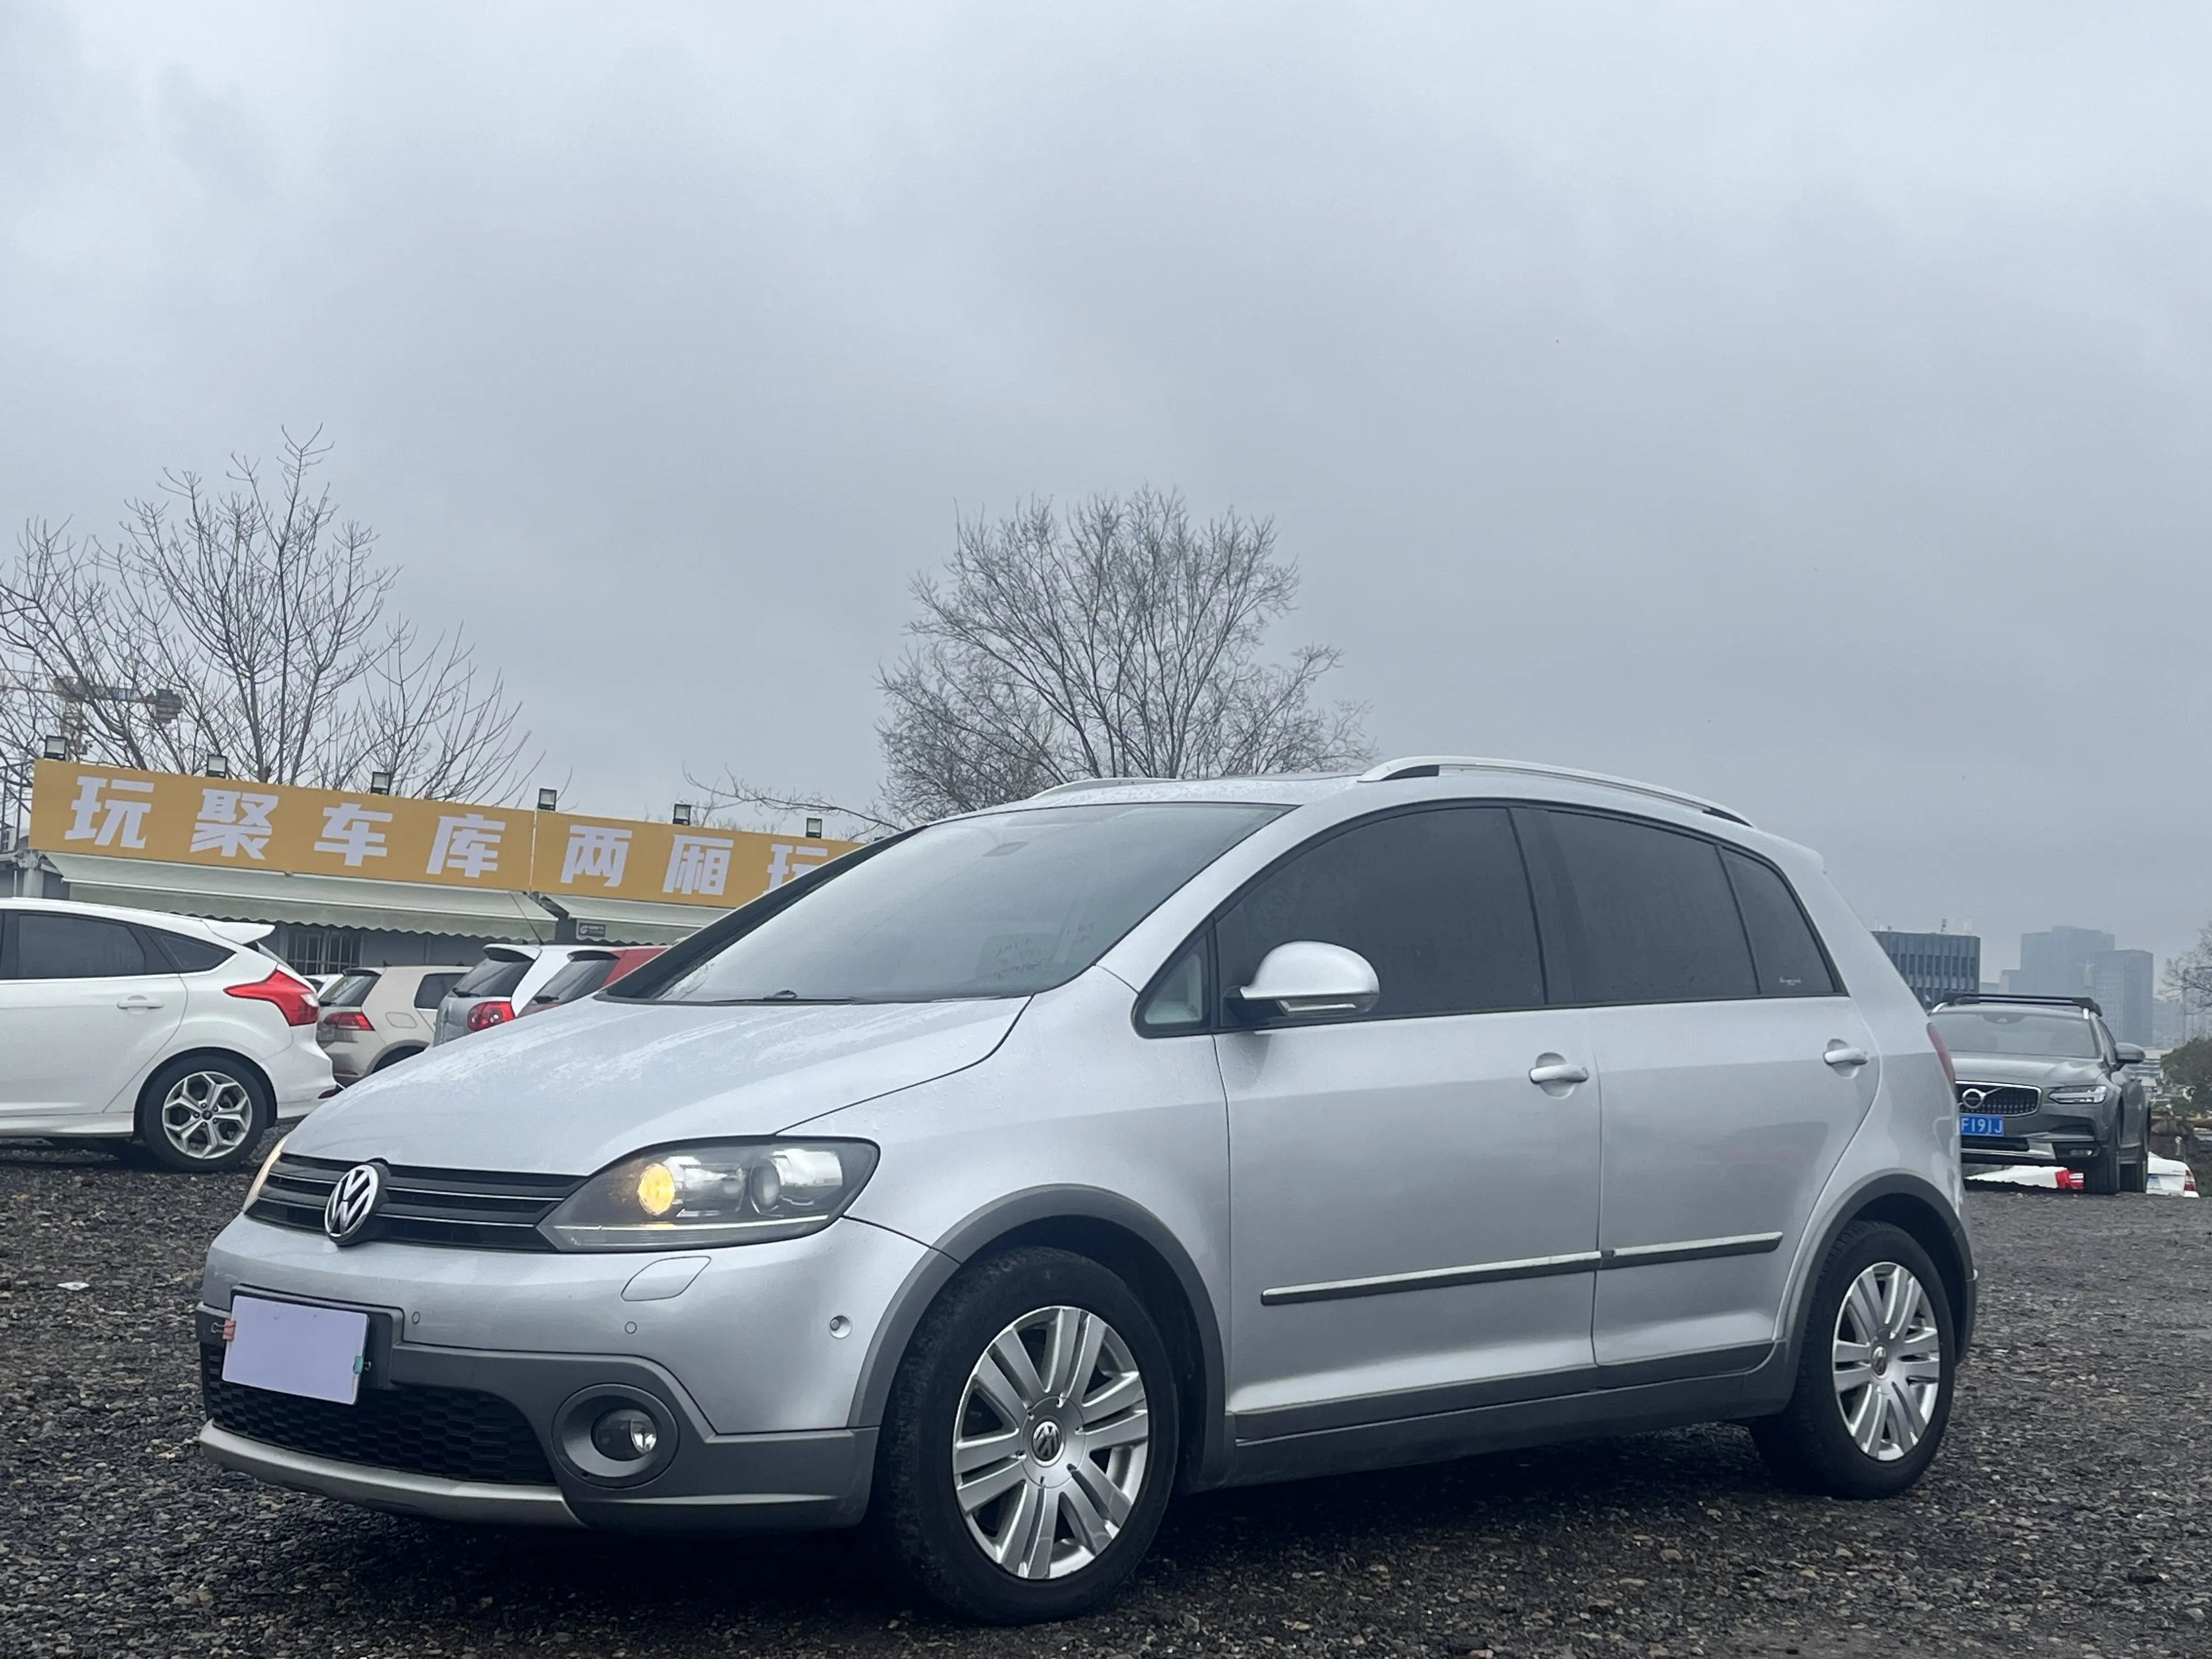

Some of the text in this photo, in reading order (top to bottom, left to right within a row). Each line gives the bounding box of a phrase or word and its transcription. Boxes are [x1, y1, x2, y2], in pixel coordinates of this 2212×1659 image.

[64, 776, 506, 878] 玩聚车库
[325, 1164, 379, 1238] VW
